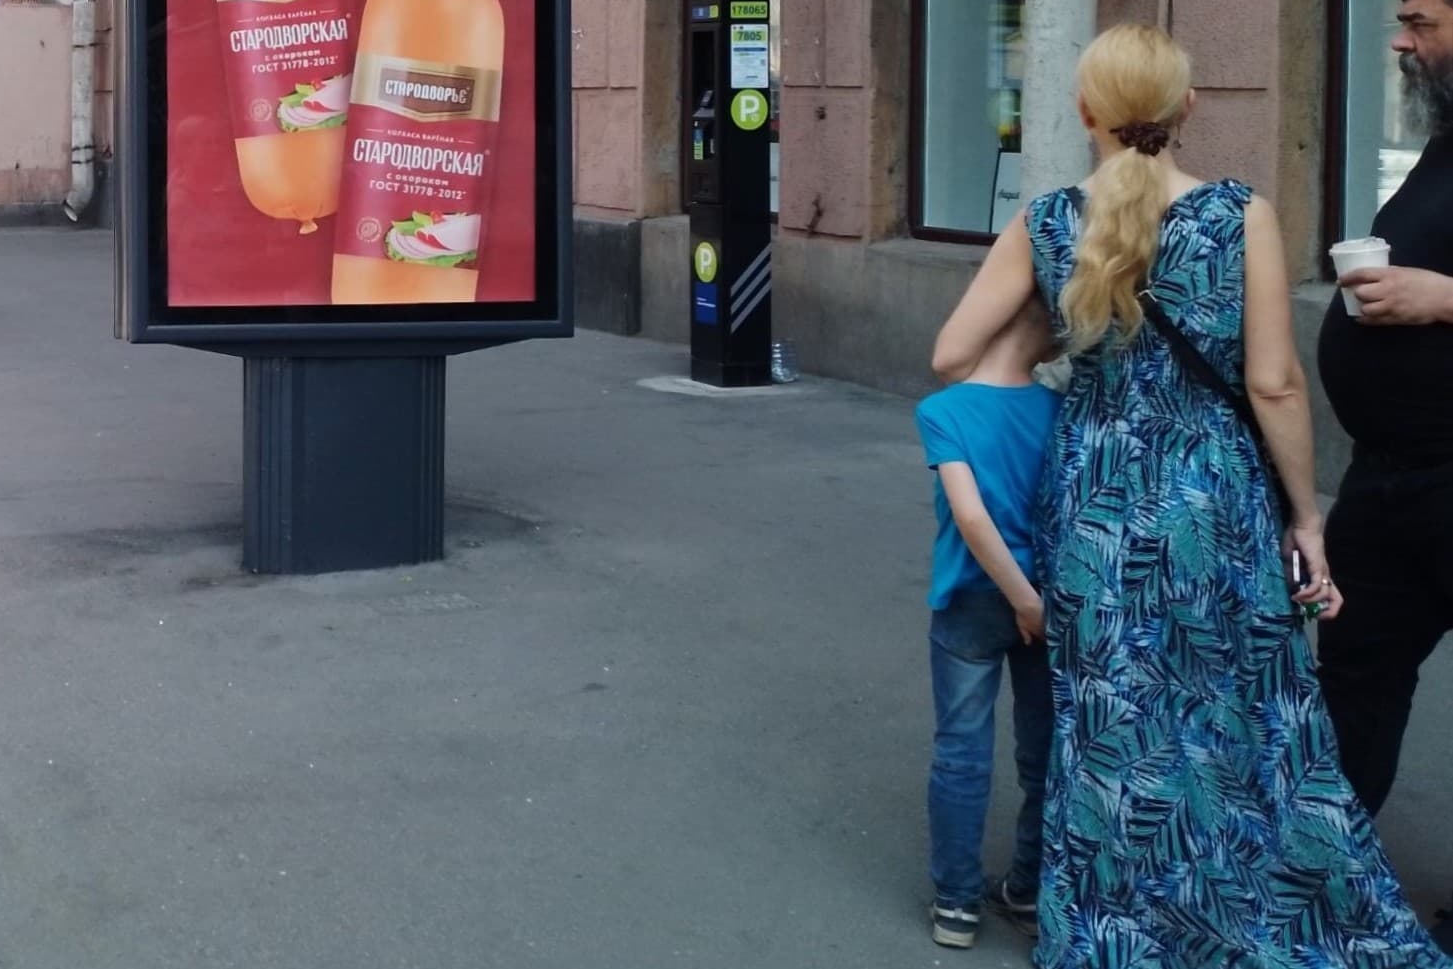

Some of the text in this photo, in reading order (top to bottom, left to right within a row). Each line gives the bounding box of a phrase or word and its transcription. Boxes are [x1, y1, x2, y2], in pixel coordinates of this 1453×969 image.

[732, 5, 766, 15] 178065
[230, 18, 348, 53] СТАРОДВОРСКАЯ
[738, 31, 762, 41] 7805
[272, 49, 321, 62] окороком
[252, 61, 280, 74] ГОСТ
[353, 138, 484, 176] СТАРОДВОРСКАЯ
[369, 179, 401, 192] ГОСТ
[395, 174, 450, 186] окороком
